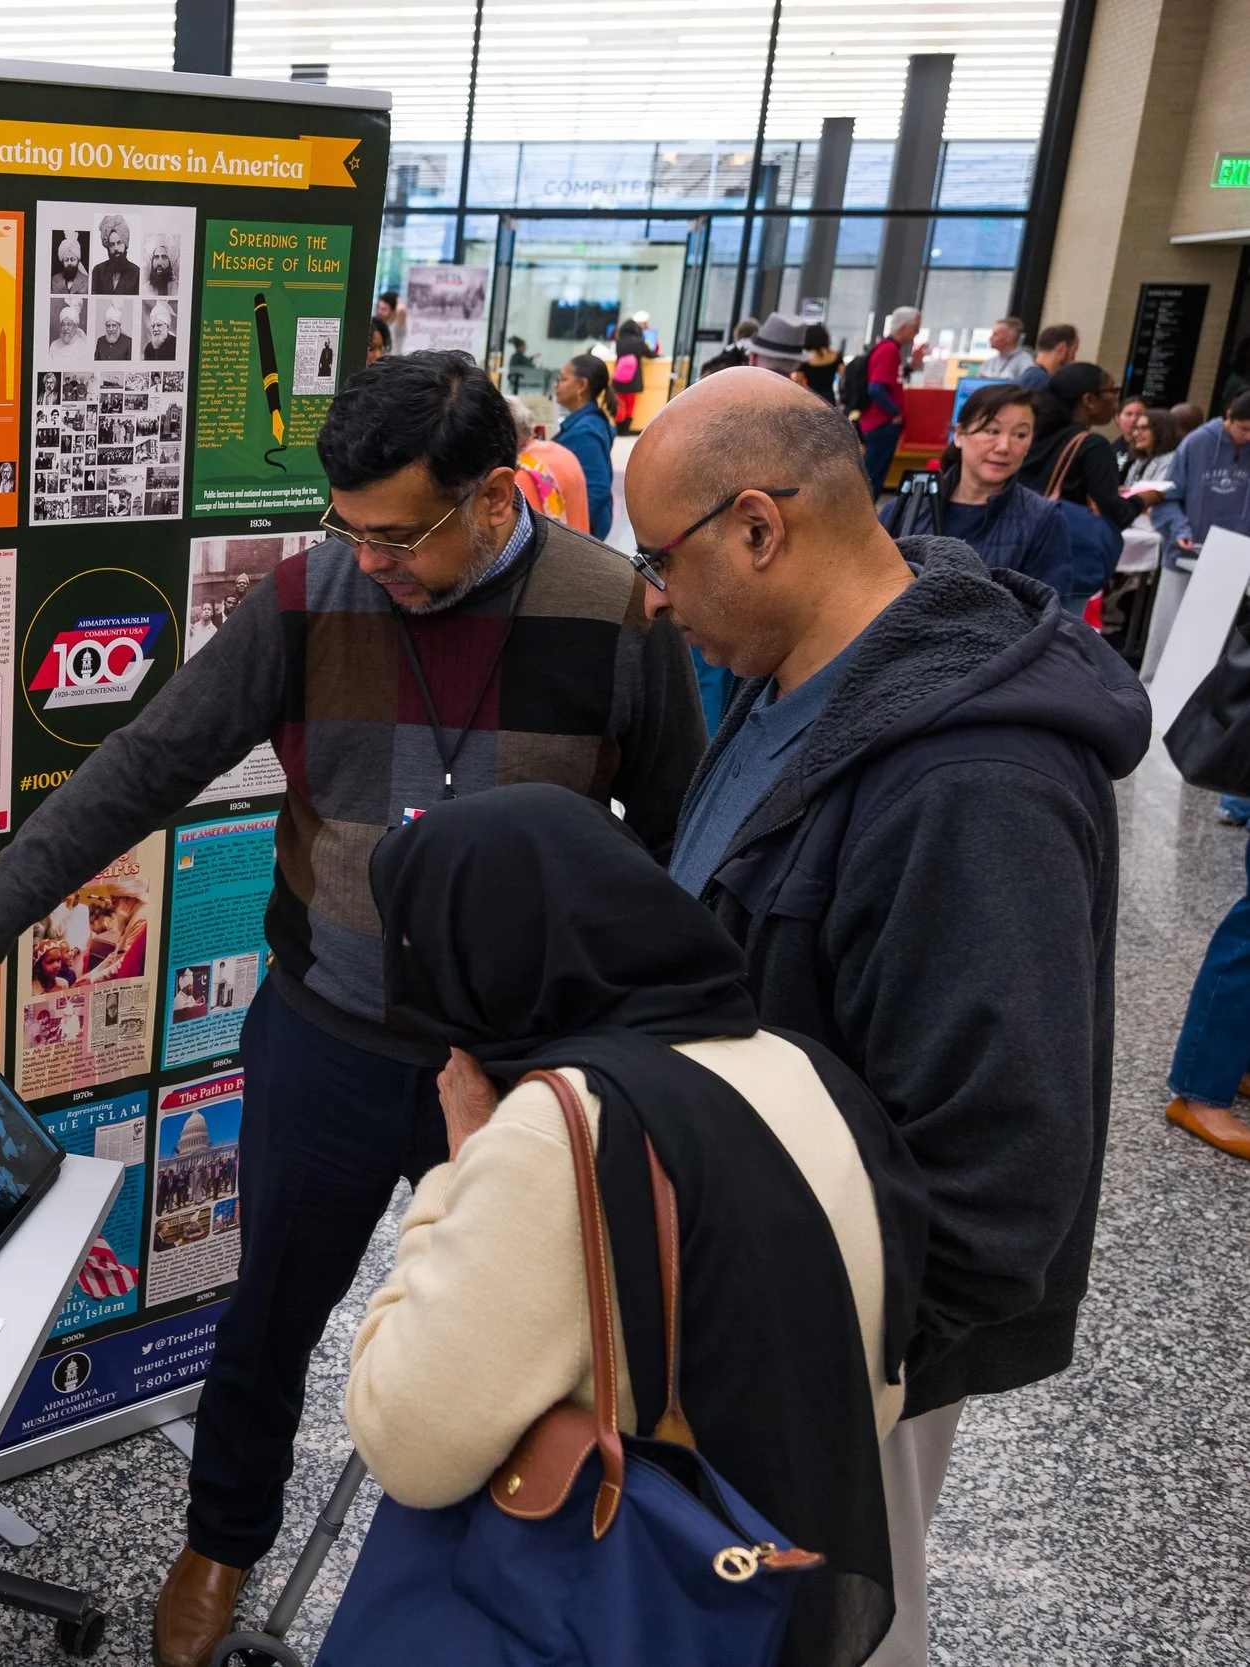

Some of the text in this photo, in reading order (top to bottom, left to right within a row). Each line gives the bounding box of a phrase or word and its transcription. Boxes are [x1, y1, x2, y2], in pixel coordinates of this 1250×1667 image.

[69, 142, 113, 169] 100
[118, 144, 182, 173] Years
[187, 149, 207, 174] in
[211, 154, 304, 180] America
[1219, 159, 1250, 185] EXI
[250, 519, 271, 528] 1930s
[78, 616, 150, 628] AHMADIYYA MUSLIM
[84, 629, 128, 638] COMMUNITY
[53, 636, 144, 689] 100
[85, 685, 128, 695] CENTENNIAL
[20, 769, 74, 792] #100Y
[229, 802, 251, 811] 1950s
[213, 1058, 232, 1068] 1980s
[73, 1091, 93, 1100] 1970s
[179, 1083, 234, 1104] The Path to
[67, 1103, 114, 1118] Representing
[48, 1119, 79, 1134] RUE
[196, 1292, 216, 1301] 2010s
[56, 1301, 126, 1329] rue Islam
[62, 1332, 85, 1345] 2000s
[155, 1323, 217, 1350] @TrueIsla
[133, 1341, 216, 1375] www.trueisla
[135, 1360, 211, 1392] 1-800-WHY-
[42, 1388, 98, 1413] AHMADIYYA
[22, 1391, 118, 1430] MUSLIM COMMUNITY
